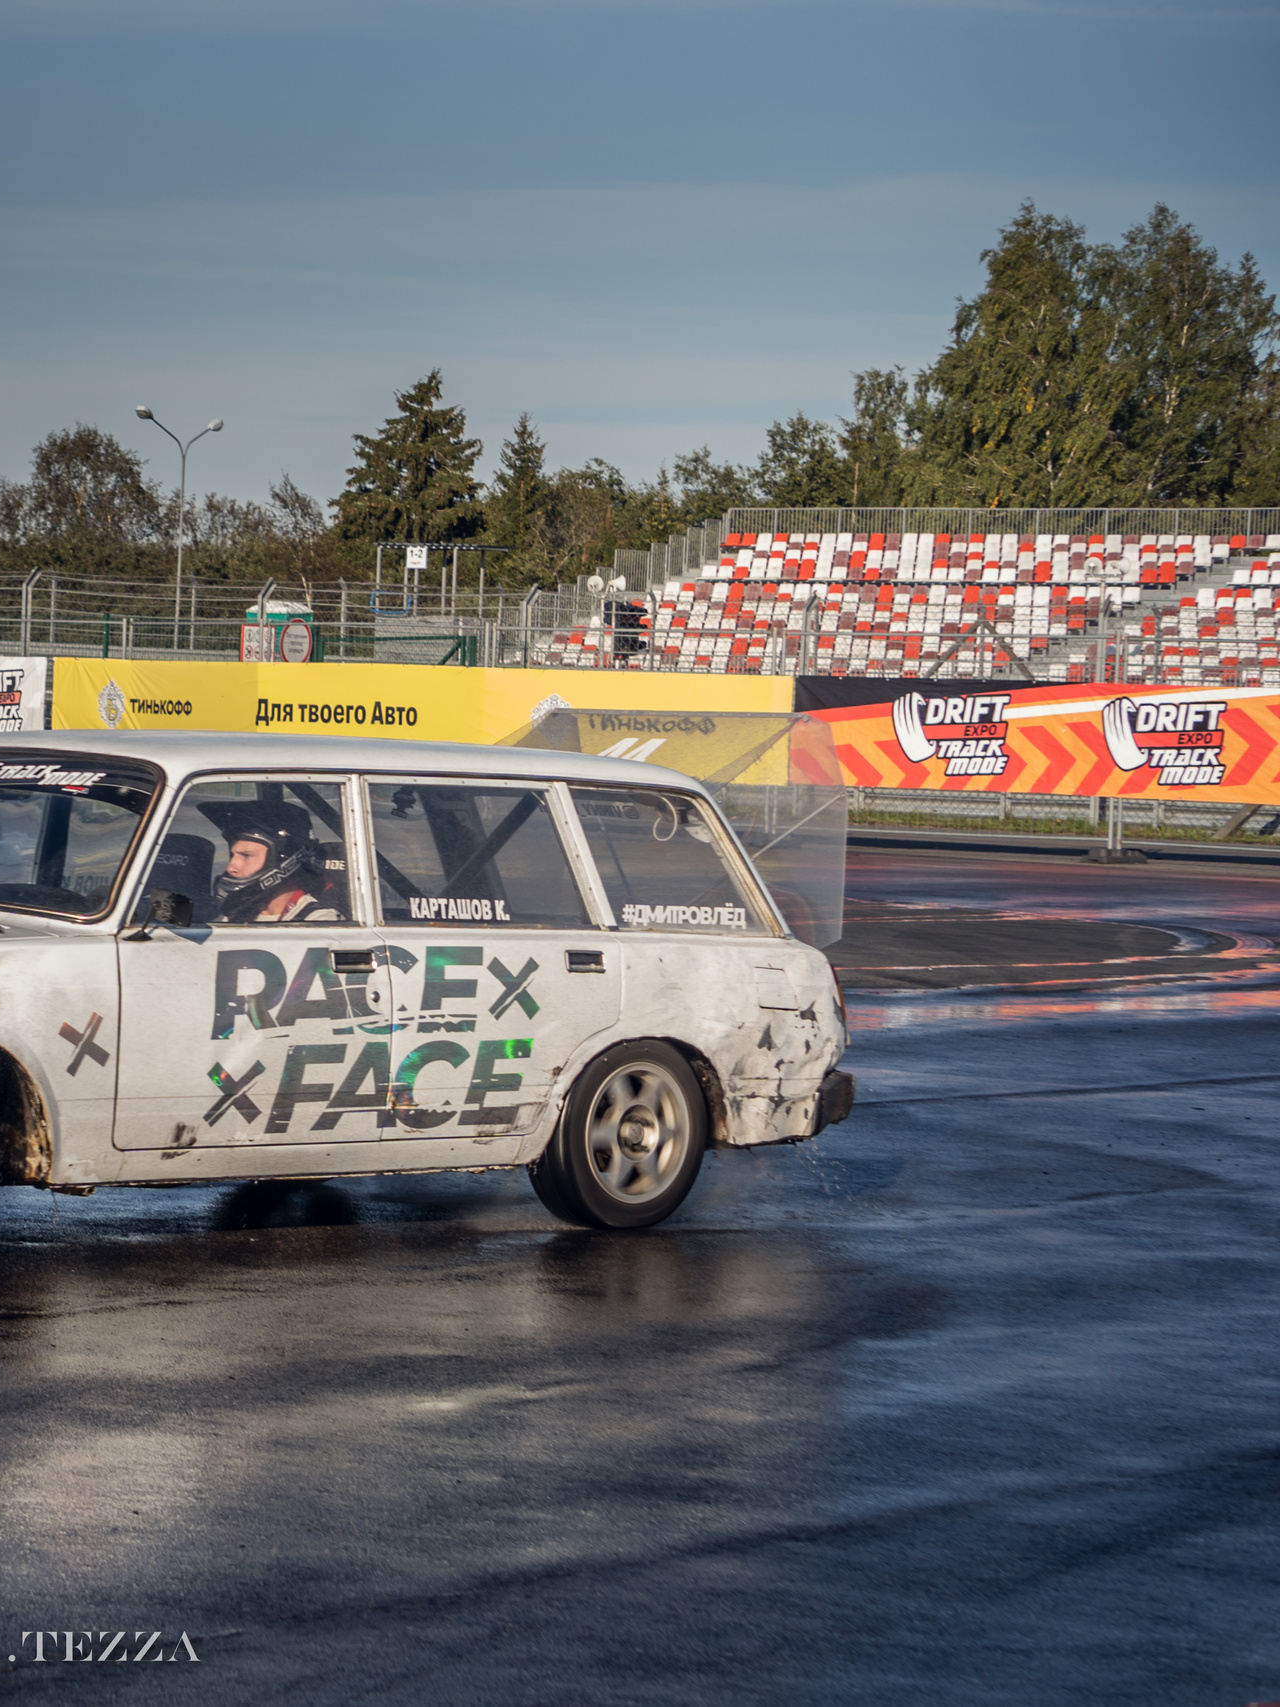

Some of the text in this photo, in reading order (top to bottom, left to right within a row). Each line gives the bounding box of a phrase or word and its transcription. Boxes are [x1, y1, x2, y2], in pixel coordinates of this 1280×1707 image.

[129, 698, 193, 716] ТИНЬКОФФ
[255, 698, 418, 726] Для твоего Авто
[925, 695, 1011, 725] DRIFT
[1135, 703, 1227, 732] DRIFT
[964, 725, 998, 737] EXPO
[1177, 733, 1213, 745] EXPO
[937, 739, 1005, 758] TRACK
[1149, 748, 1222, 766] TRACK
[945, 757, 1009, 775] MODE
[1158, 766, 1226, 784] MODE
[38, 771, 107, 786] MODE
[409, 897, 511, 921] КАРТАШОВ К.
[210, 945, 484, 1040] RACE
[264, 1038, 534, 1135] FACE
